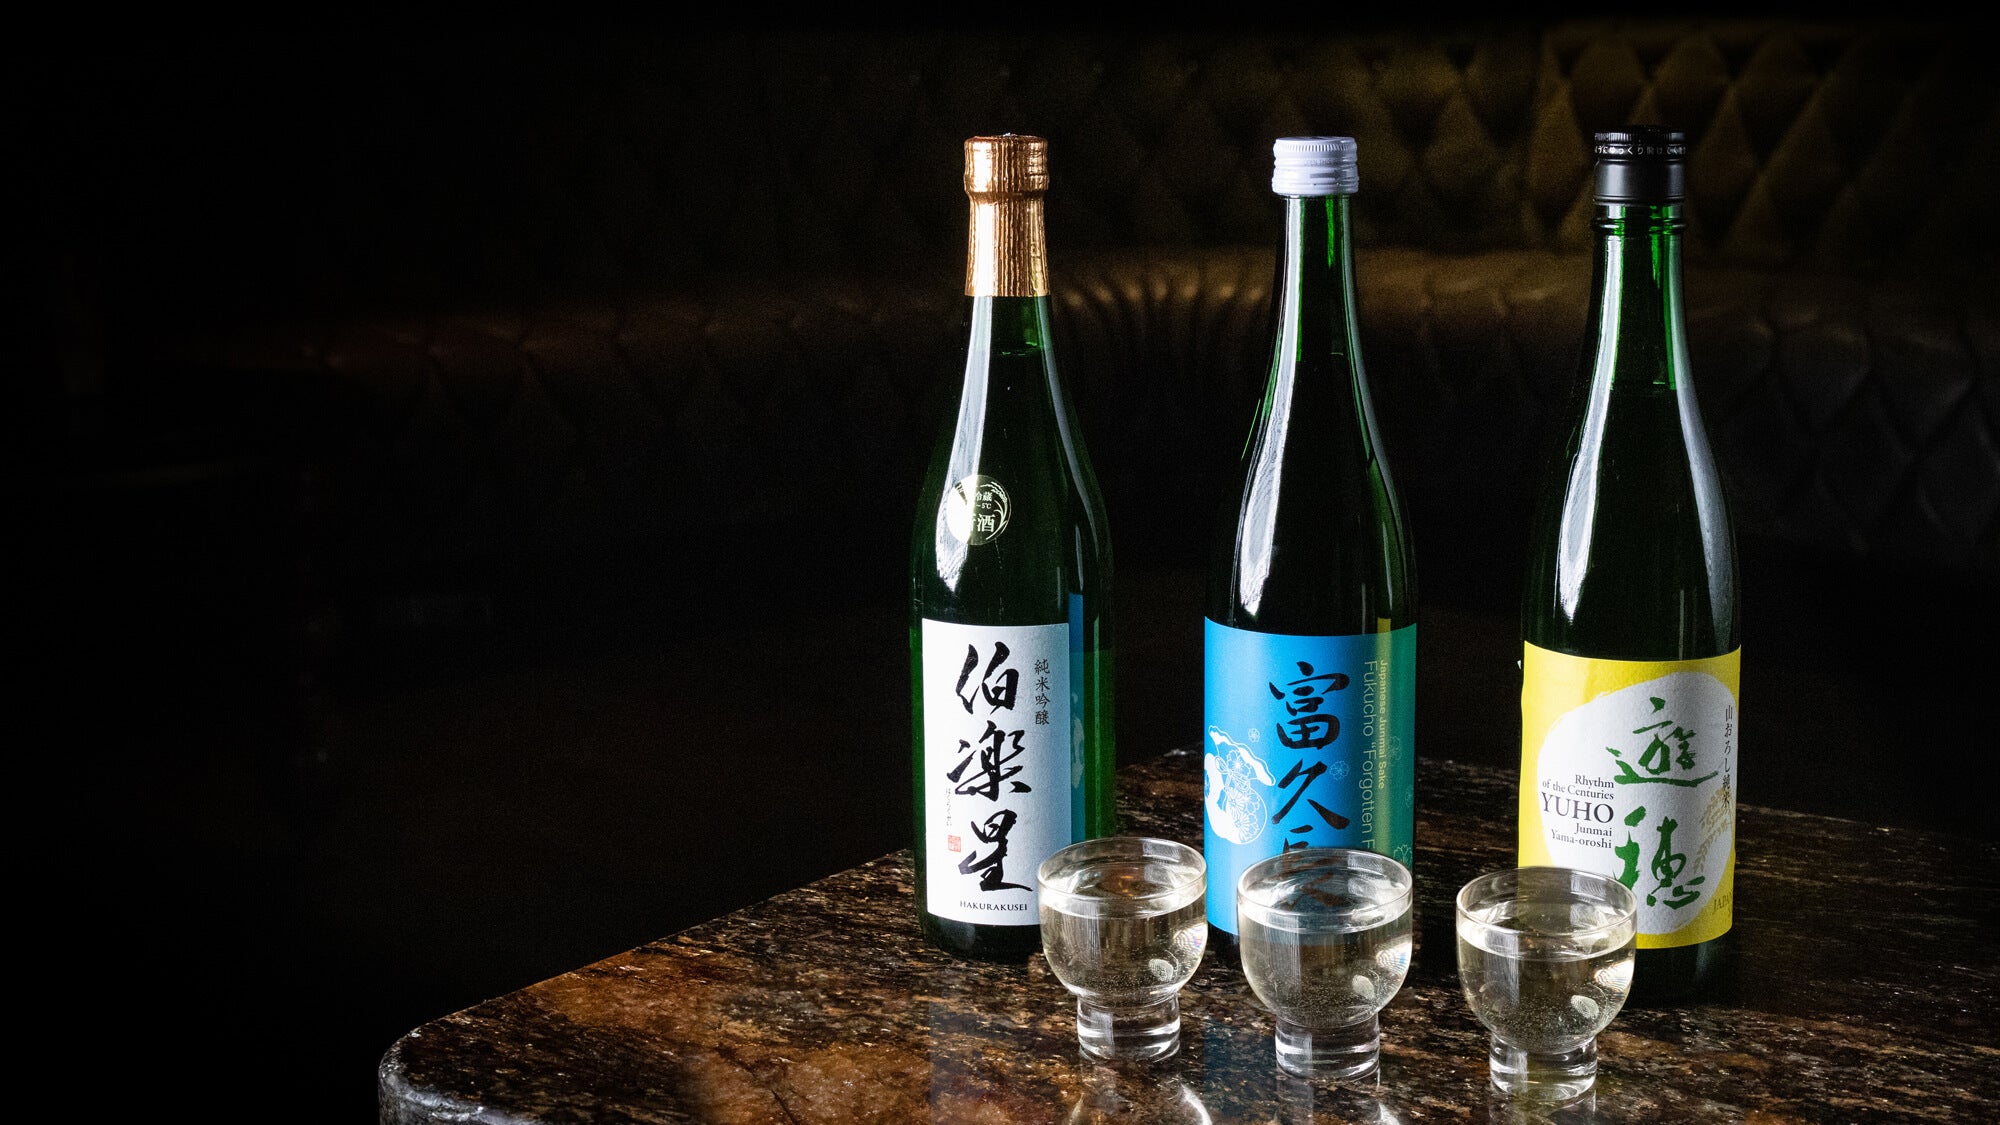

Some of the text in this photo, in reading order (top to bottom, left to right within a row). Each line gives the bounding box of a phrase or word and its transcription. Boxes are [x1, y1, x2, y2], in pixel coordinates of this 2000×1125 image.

[1361, 660, 1377, 737] Fukucho
[1377, 659, 1387, 790] Japanese Junmai Sake
[1541, 778, 1615, 800] of the Centuries
[1574, 774, 1615, 789] Rhythm
[1541, 791, 1614, 824] YUHO
[1551, 828, 1612, 849] Yama-oroshi
[1573, 822, 1612, 837] Junmai
[959, 899, 1028, 912] HAKURAKUSEI
